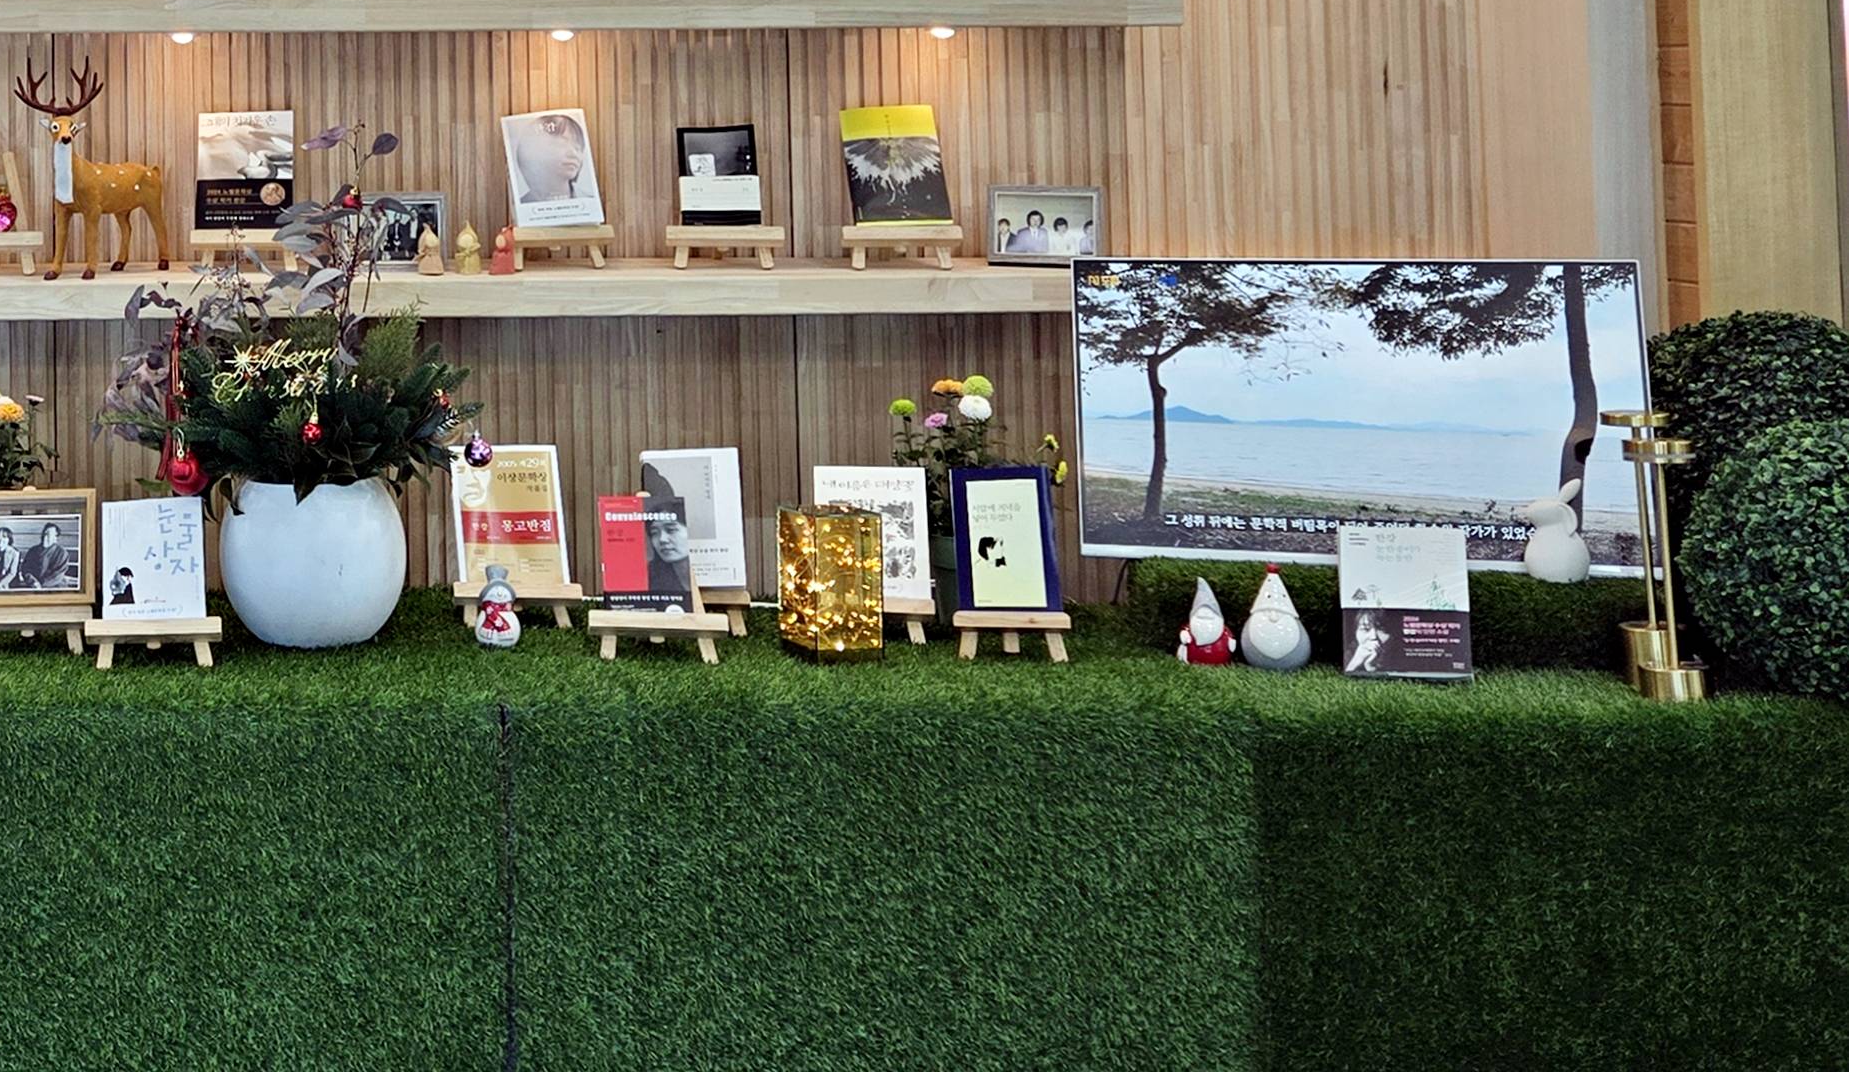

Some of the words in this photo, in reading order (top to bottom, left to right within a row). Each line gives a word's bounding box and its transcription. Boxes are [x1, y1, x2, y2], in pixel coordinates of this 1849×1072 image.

[501, 519, 552, 533] 몽고반점
[1164, 514, 1178, 525] 그
[1208, 516, 1246, 530] 뒤에는
[1250, 517, 1287, 531] 문학적
